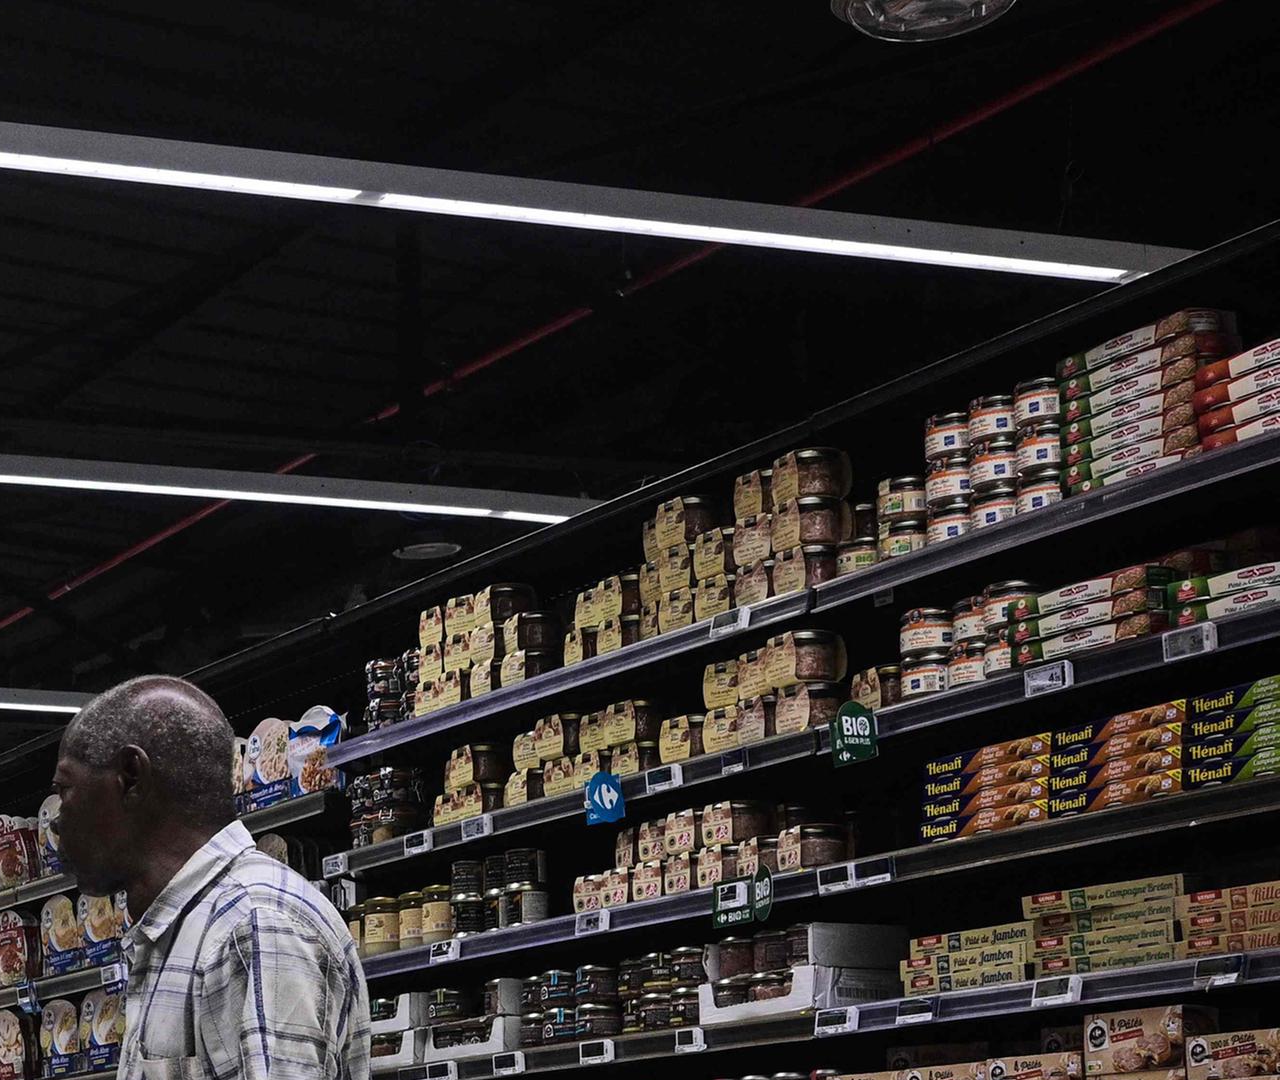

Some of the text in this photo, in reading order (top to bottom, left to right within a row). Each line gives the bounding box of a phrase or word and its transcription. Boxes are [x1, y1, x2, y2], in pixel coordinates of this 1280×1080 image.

[1192, 690, 1235, 714] Hénaff
[841, 715, 871, 737] BIO
[1055, 725, 1093, 746] Hénaff
[1191, 714, 1235, 737] Hénaff
[1051, 748, 1088, 769] Hénaff
[1189, 738, 1234, 761] Hénaff
[926, 756, 963, 776] Hénaff
[1188, 762, 1233, 785] Hénaff
[925, 777, 961, 797] Hénaff
[1050, 771, 1087, 791] Hénaff
[924, 799, 960, 818] Hénaff
[1049, 793, 1087, 813] Hénaff
[921, 820, 958, 839] Hénaff
[991, 927, 1027, 945] Jambon
[978, 949, 1013, 967] Jambon
[980, 970, 1013, 987] Jambon
